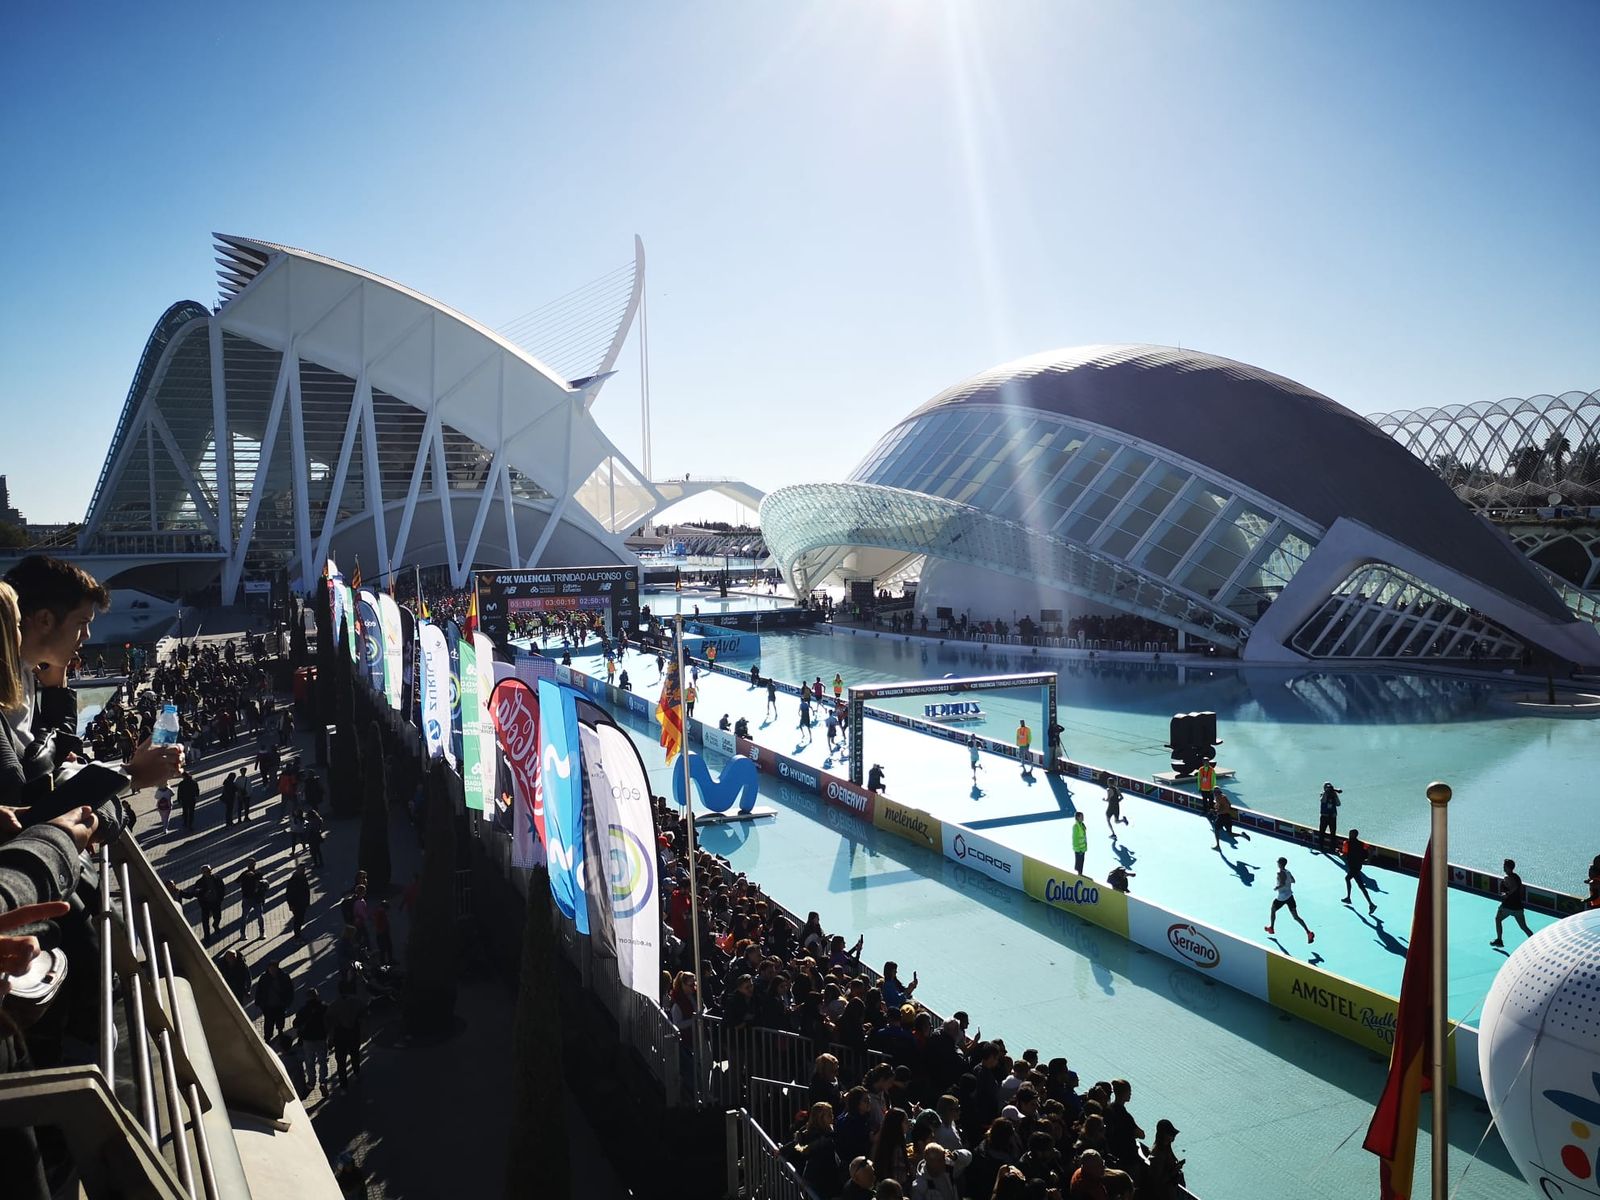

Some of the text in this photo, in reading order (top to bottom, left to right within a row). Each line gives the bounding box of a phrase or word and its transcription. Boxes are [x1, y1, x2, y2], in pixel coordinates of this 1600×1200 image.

[496, 571, 622, 584] 42K VALENCIA TRINIDAD ALFONSO
[789, 767, 817, 789] HYUNDAI
[838, 786, 868, 812] ENERVIT
[884, 806, 931, 840] meléndez
[968, 848, 1012, 874] COROS
[1045, 878, 1099, 904] ColaCao
[1171, 929, 1216, 961] Serrano
[1290, 978, 1398, 1030] AMSTEL Radl
